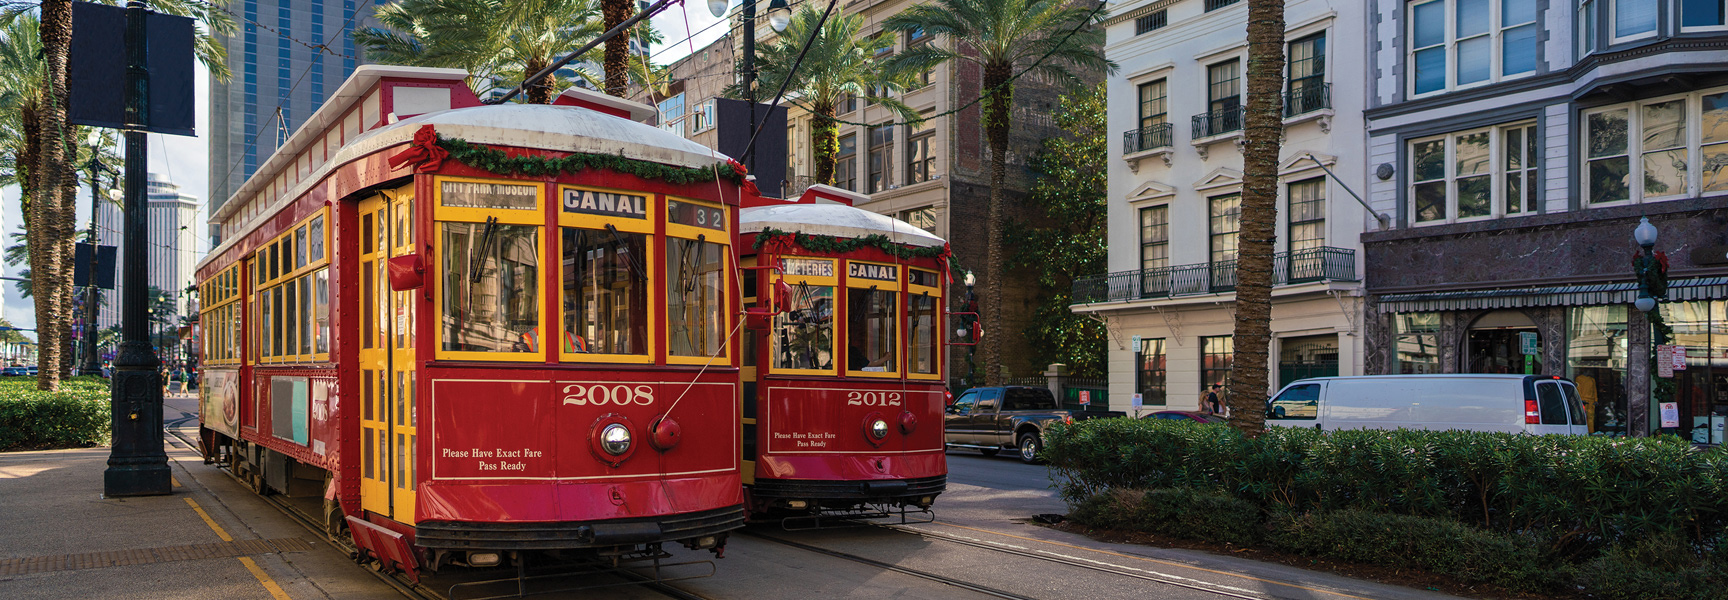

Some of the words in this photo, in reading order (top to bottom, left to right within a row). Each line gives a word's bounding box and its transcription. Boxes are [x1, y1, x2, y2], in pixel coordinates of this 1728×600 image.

[564, 189, 646, 214] CANAL
[849, 263, 896, 280] CANAL
[562, 384, 654, 406] 2008
[848, 391, 901, 406] 2012
[810, 440, 827, 448] Ready
[442, 448, 469, 458] Please
[472, 448, 493, 458] Have
[496, 448, 521, 458] Exact
[524, 448, 542, 458] Fare
[479, 460, 498, 471] Pass
[500, 460, 527, 472] Ready
